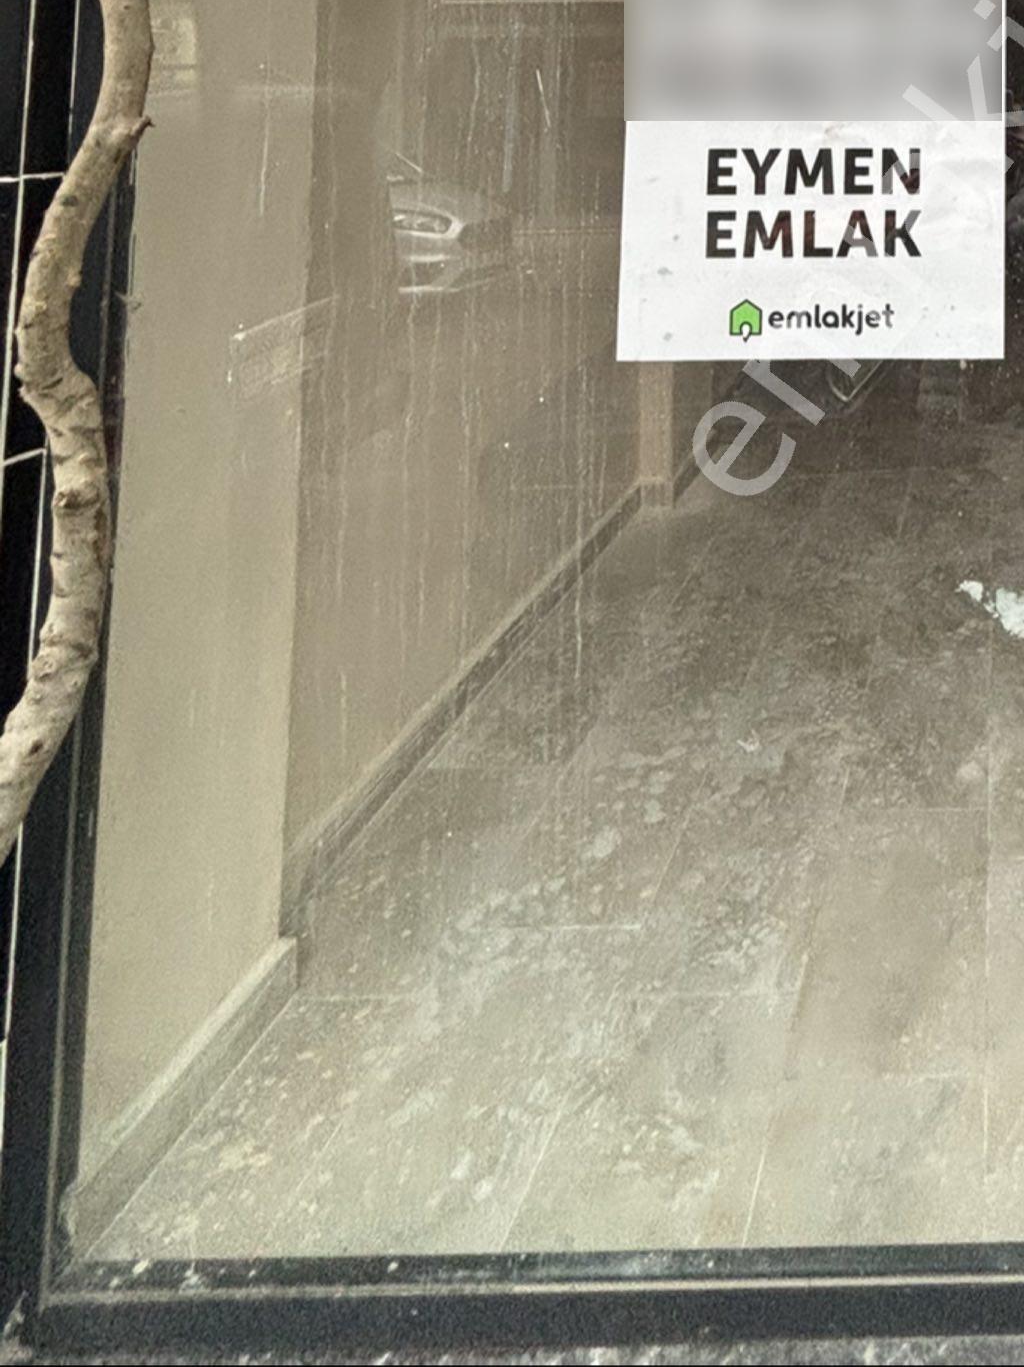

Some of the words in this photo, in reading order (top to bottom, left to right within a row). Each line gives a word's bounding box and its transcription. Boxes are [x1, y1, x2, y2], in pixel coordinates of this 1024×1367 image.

[706, 148, 921, 196] EYMEN
[706, 210, 922, 259] EMLAK
[768, 303, 894, 336] emlakjet
